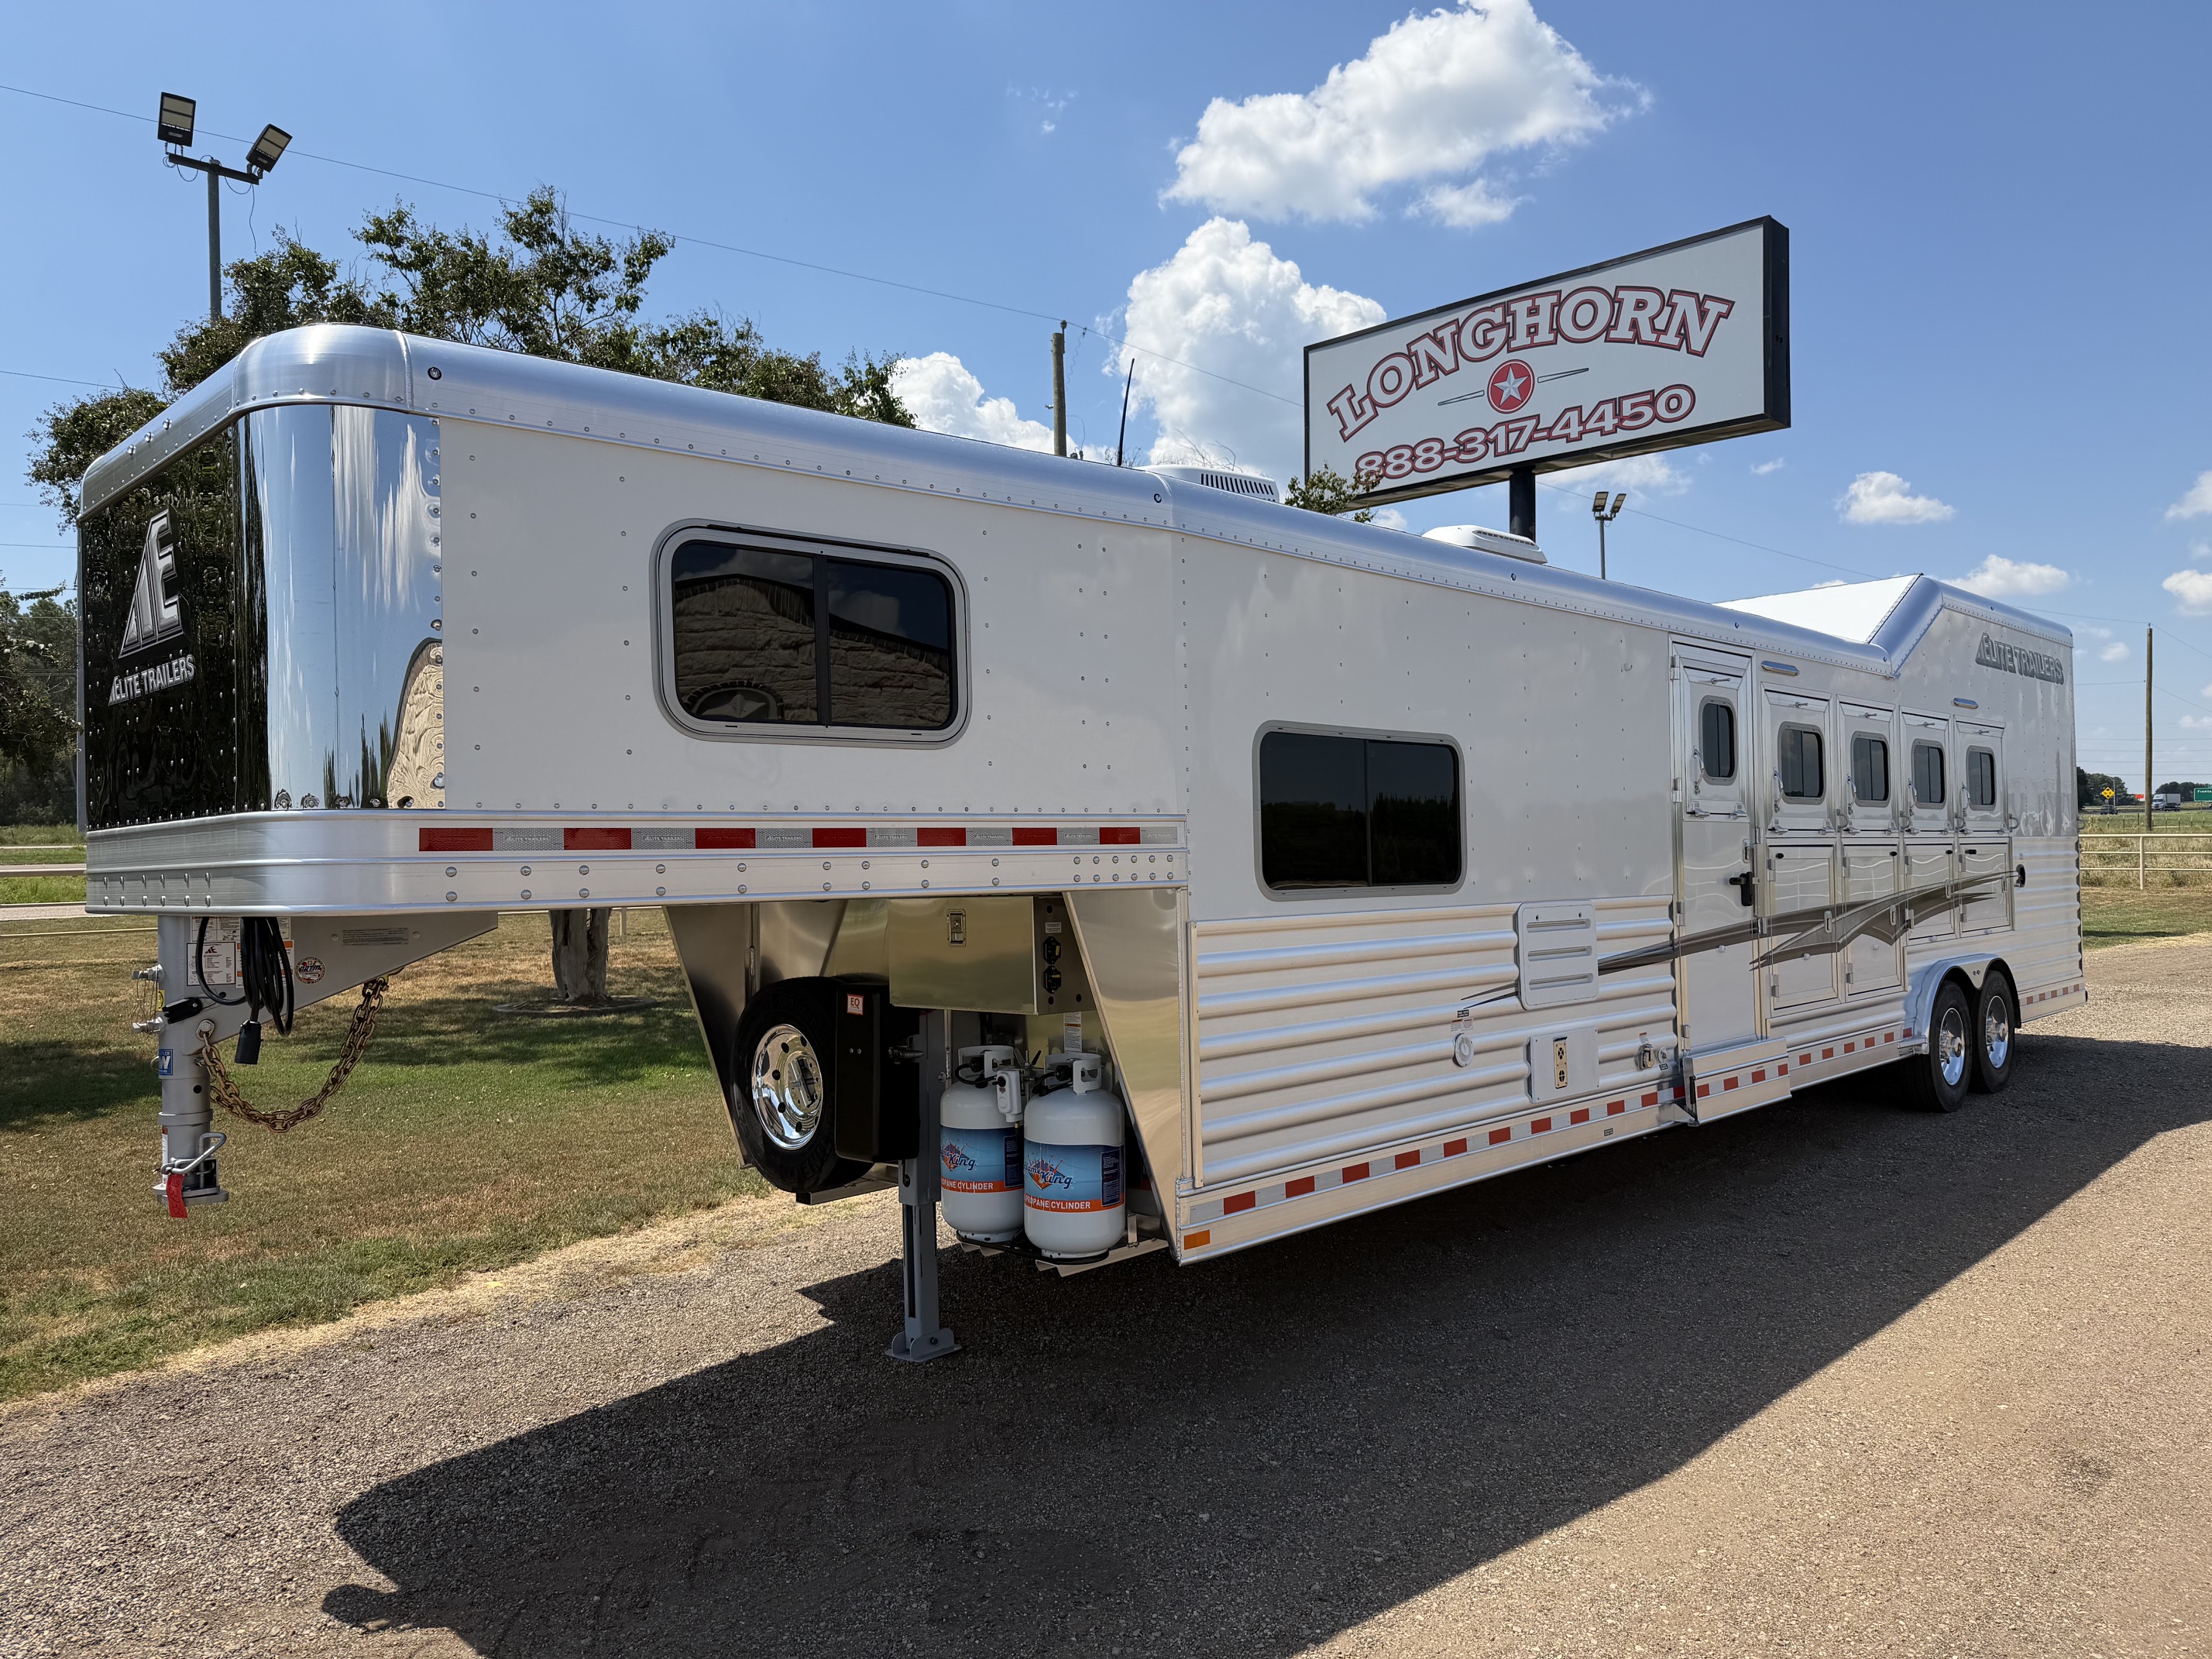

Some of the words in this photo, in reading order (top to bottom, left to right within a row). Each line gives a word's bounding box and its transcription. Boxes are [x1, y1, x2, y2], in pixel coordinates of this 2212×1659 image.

[1327, 285, 1736, 442] LONGHORN
[1355, 383, 1696, 486] 888-317-4450
[1976, 632, 2016, 674] ELITE
[2014, 646, 2064, 685] TRAILERS
[108, 672, 141, 706] ELITE
[141, 654, 196, 695] TRAILERS
[850, 998, 860, 1010] EQ
[948, 1152, 978, 1171] King
[957, 1181, 994, 1190] CYLINDER
[1040, 1170, 1076, 1190] King
[1025, 1194, 1049, 1208] PROPANE
[1051, 1201, 1091, 1210] CYLINDER
